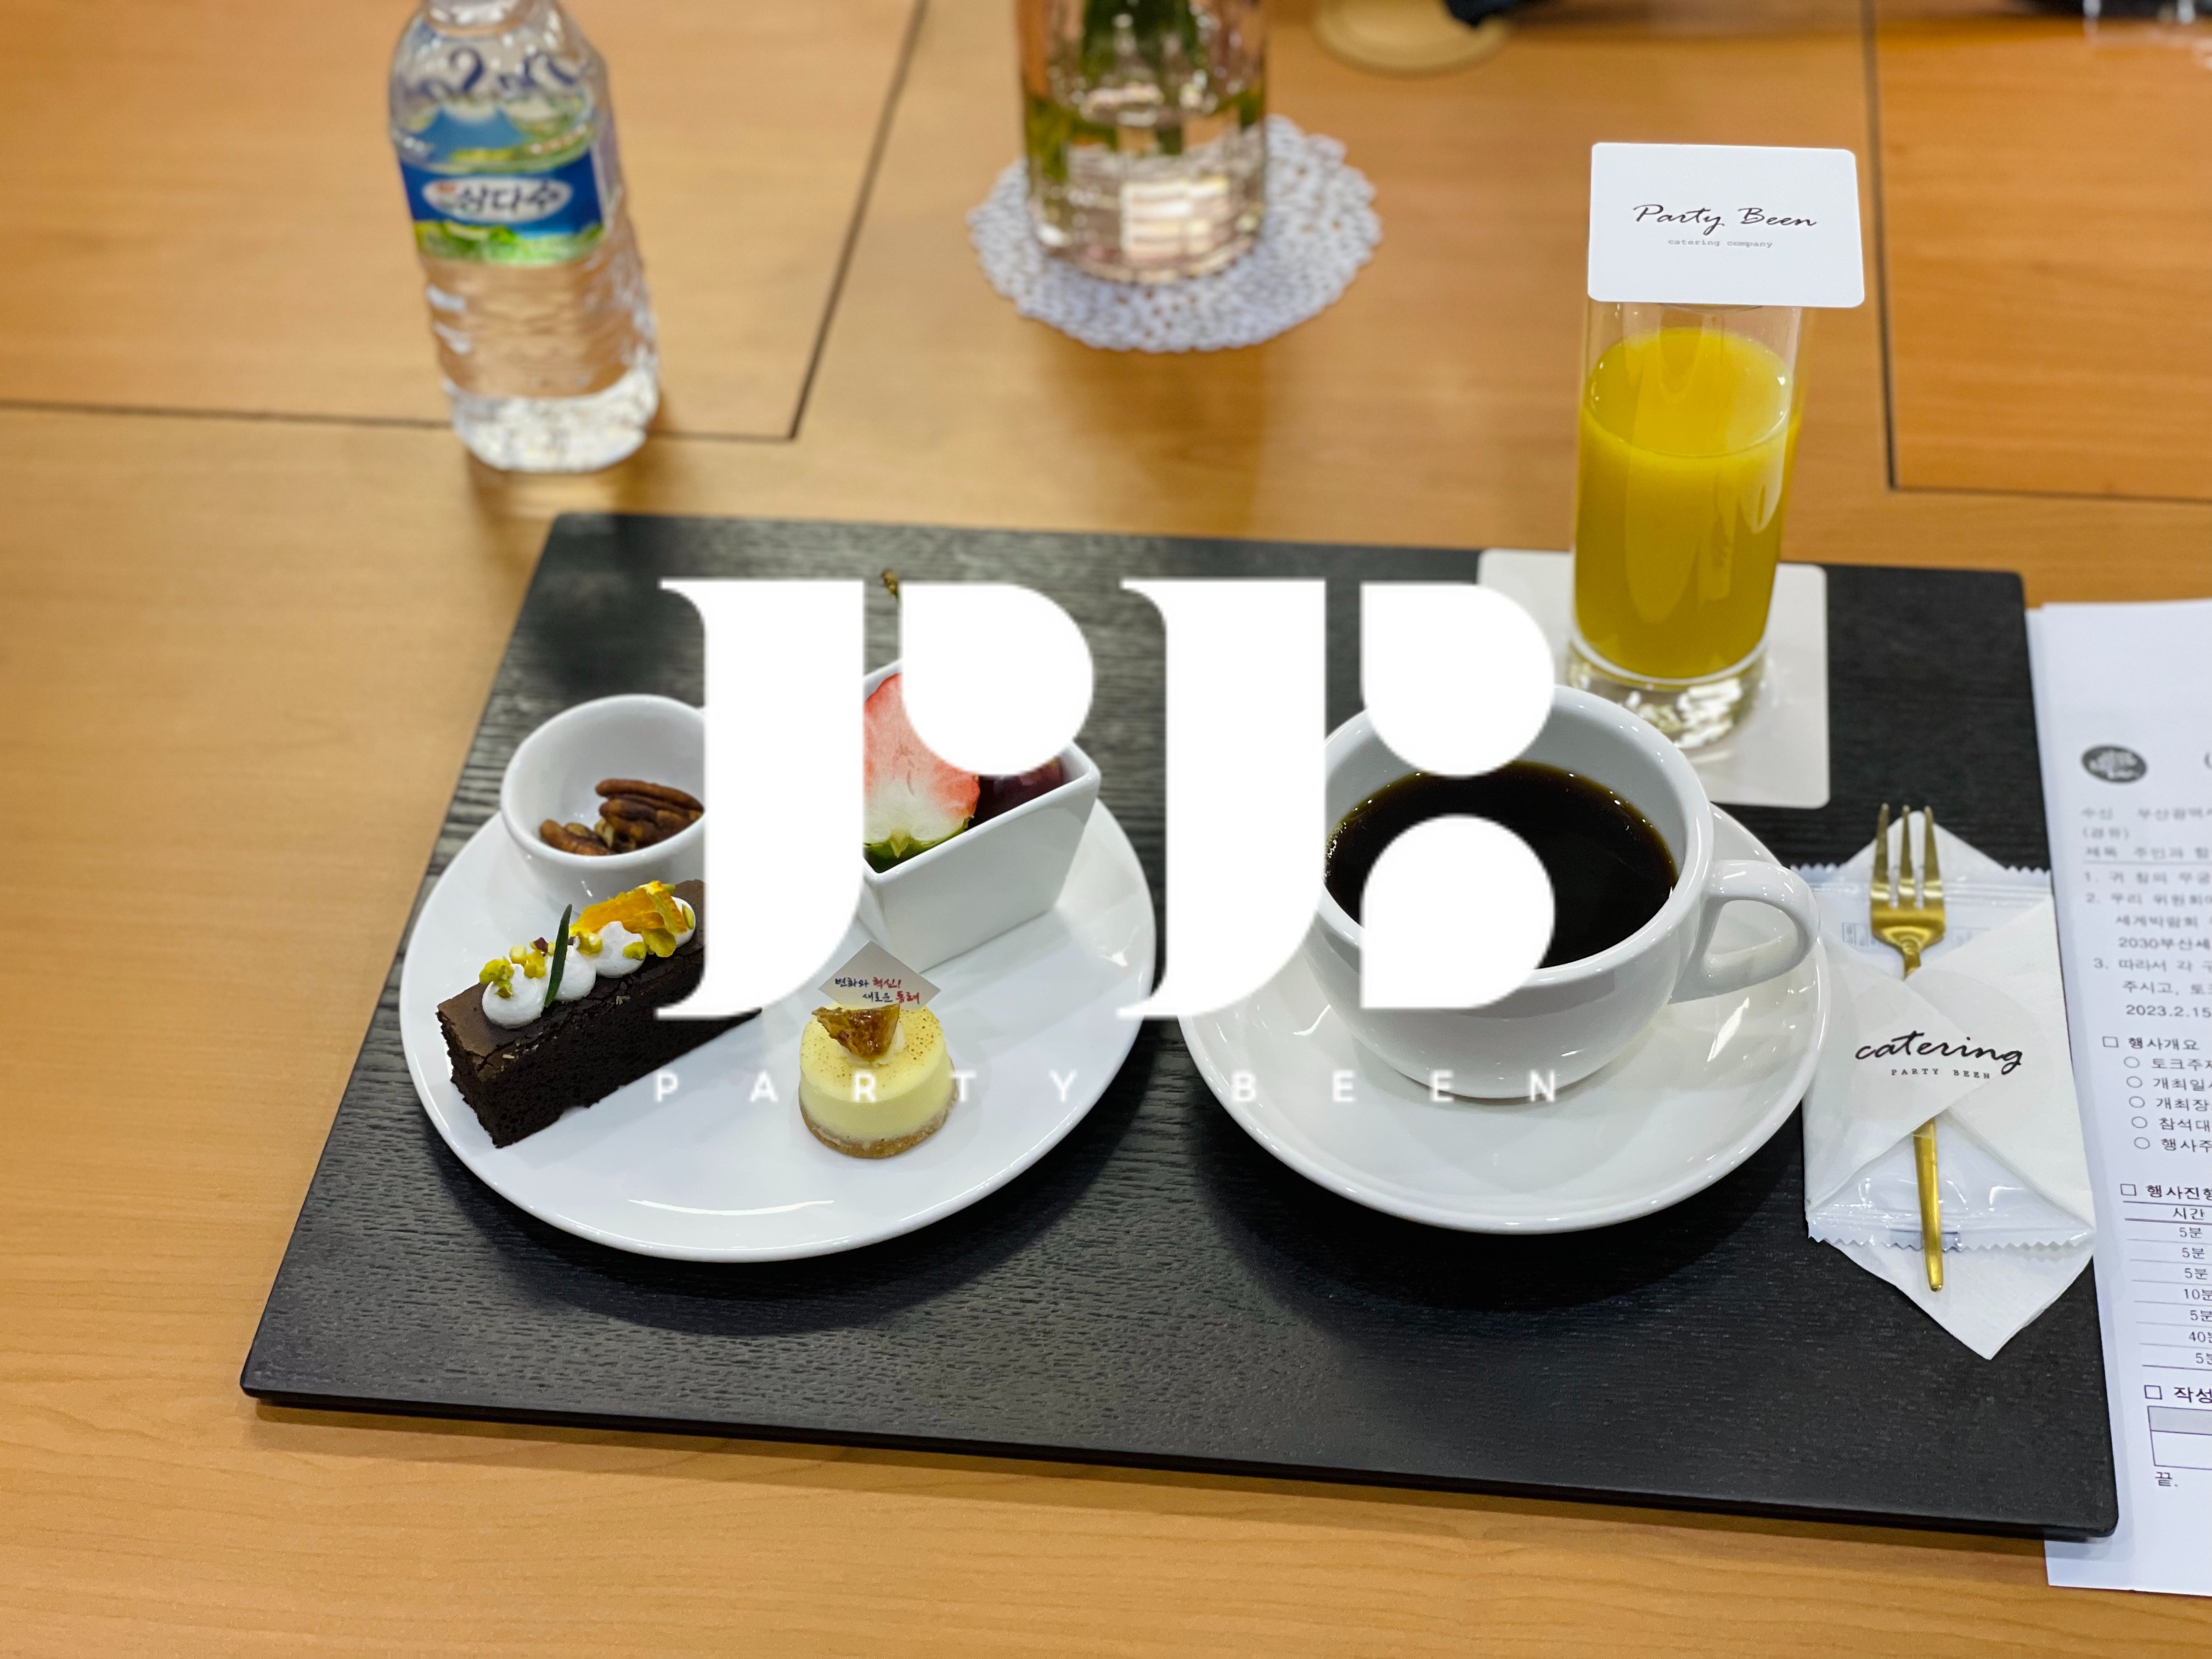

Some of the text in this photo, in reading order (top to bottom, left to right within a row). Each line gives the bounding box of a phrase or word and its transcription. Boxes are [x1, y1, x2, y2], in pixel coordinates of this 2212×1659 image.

[1633, 204, 1818, 235] Party Been
[1668, 239, 1773, 249] catering company
[2137, 808, 2212, 821] 부산광역
[2118, 958, 2167, 972] 따라서
[834, 977, 901, 989] 변화와 혁신!
[862, 990, 920, 1004] 새로운 동래
[2127, 1036, 2200, 1051] 행사개요
[1855, 1030, 2023, 1075] catering
[1953, 1069, 1990, 1079] BEEN
[2152, 1077, 2212, 1092] 개최일
[2155, 1097, 2212, 1112] 개최장
[2172, 1207, 2205, 1220] 시간
[2179, 1227, 2203, 1239] 5분
[2181, 1247, 2205, 1260] 5분
[2184, 1267, 2208, 1280] 5분
[2183, 1288, 2212, 1301] 10분
[2174, 1387, 2212, 1404] 작성
